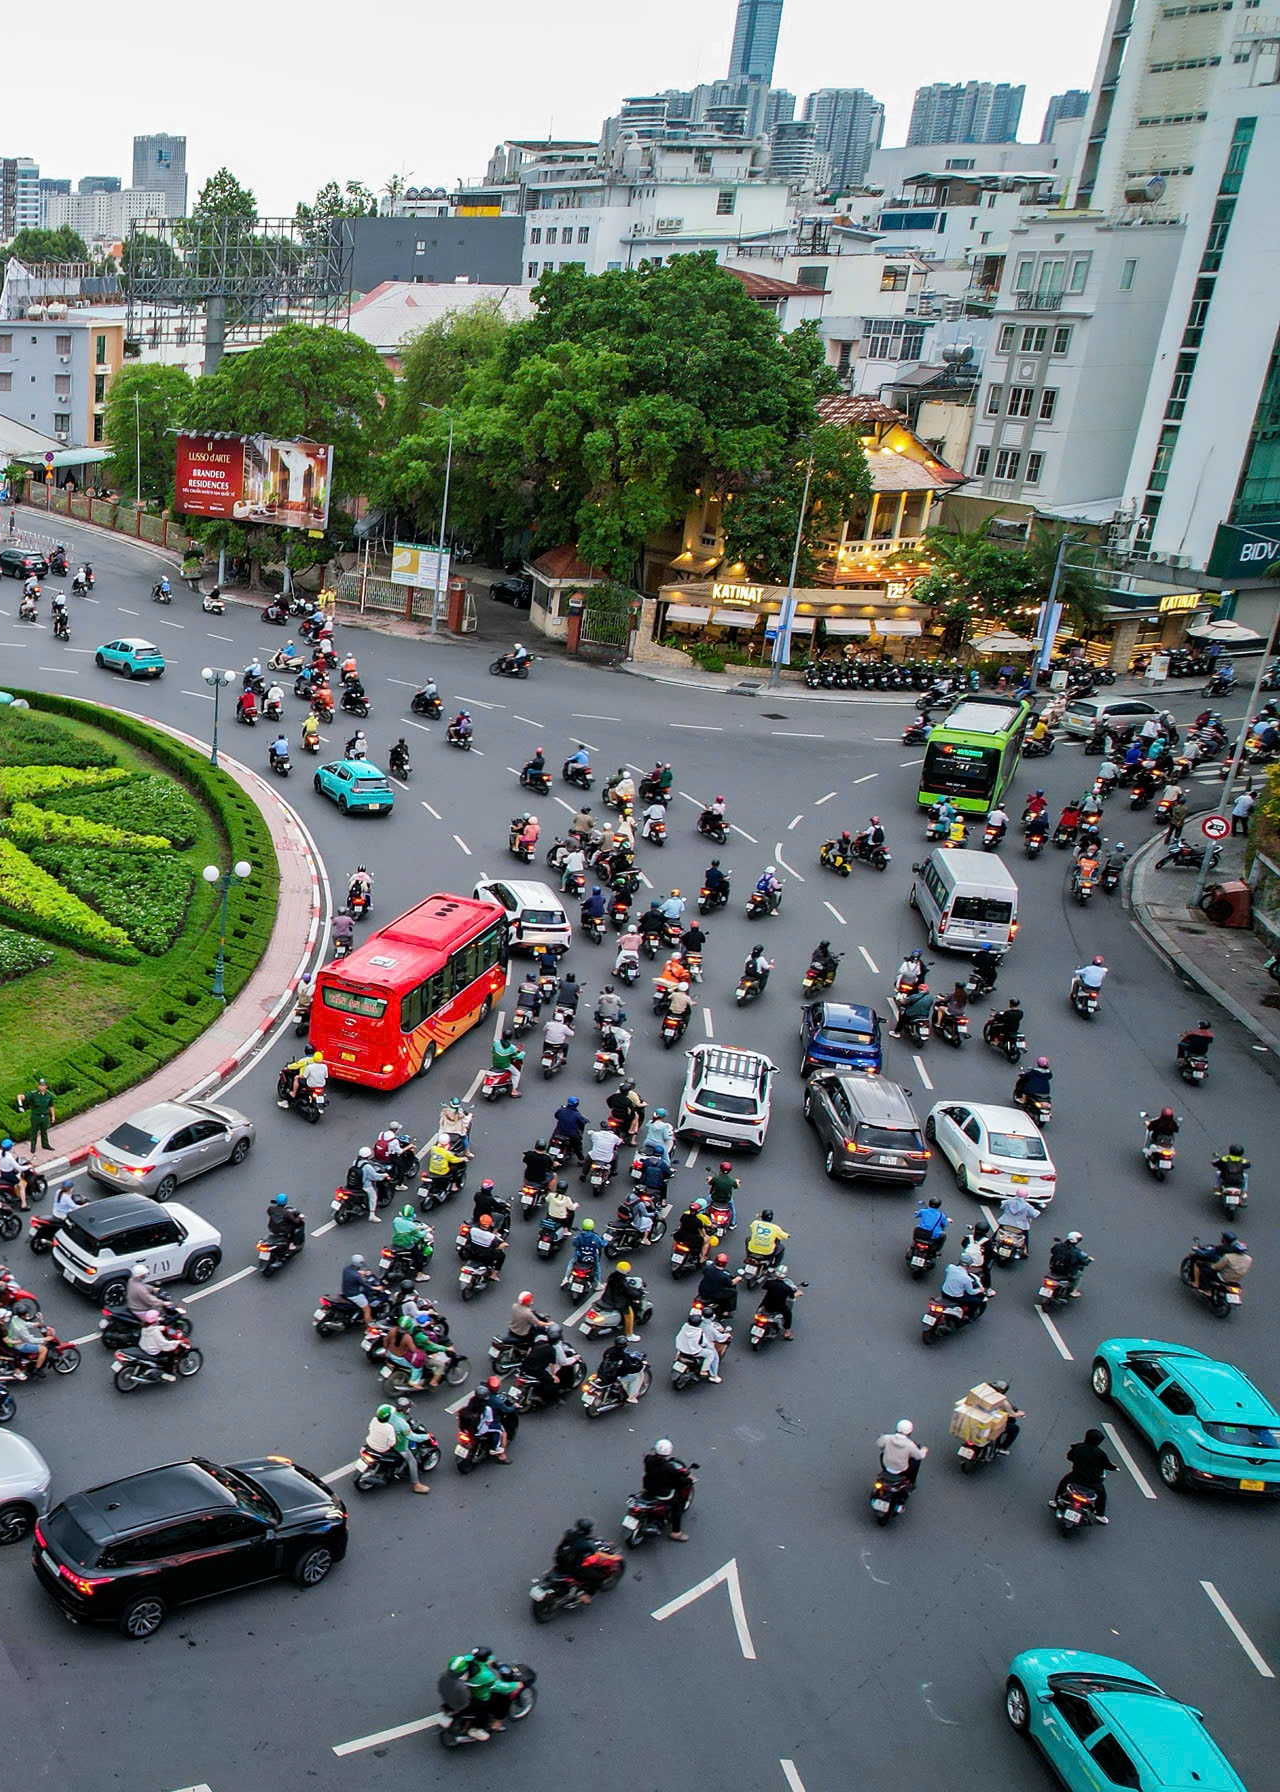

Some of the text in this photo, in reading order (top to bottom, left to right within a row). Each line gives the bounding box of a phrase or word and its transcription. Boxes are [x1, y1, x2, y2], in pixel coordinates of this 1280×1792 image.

[188, 452, 209, 462] LUSSO
[192, 468, 226, 479] BRANDED
[188, 479, 229, 491] RESIDENCES
[1240, 542, 1279, 561] BIDV
[712, 583, 765, 603] KATINAT
[1159, 594, 1202, 612] KATINAT
[756, 1223, 771, 1236] be
